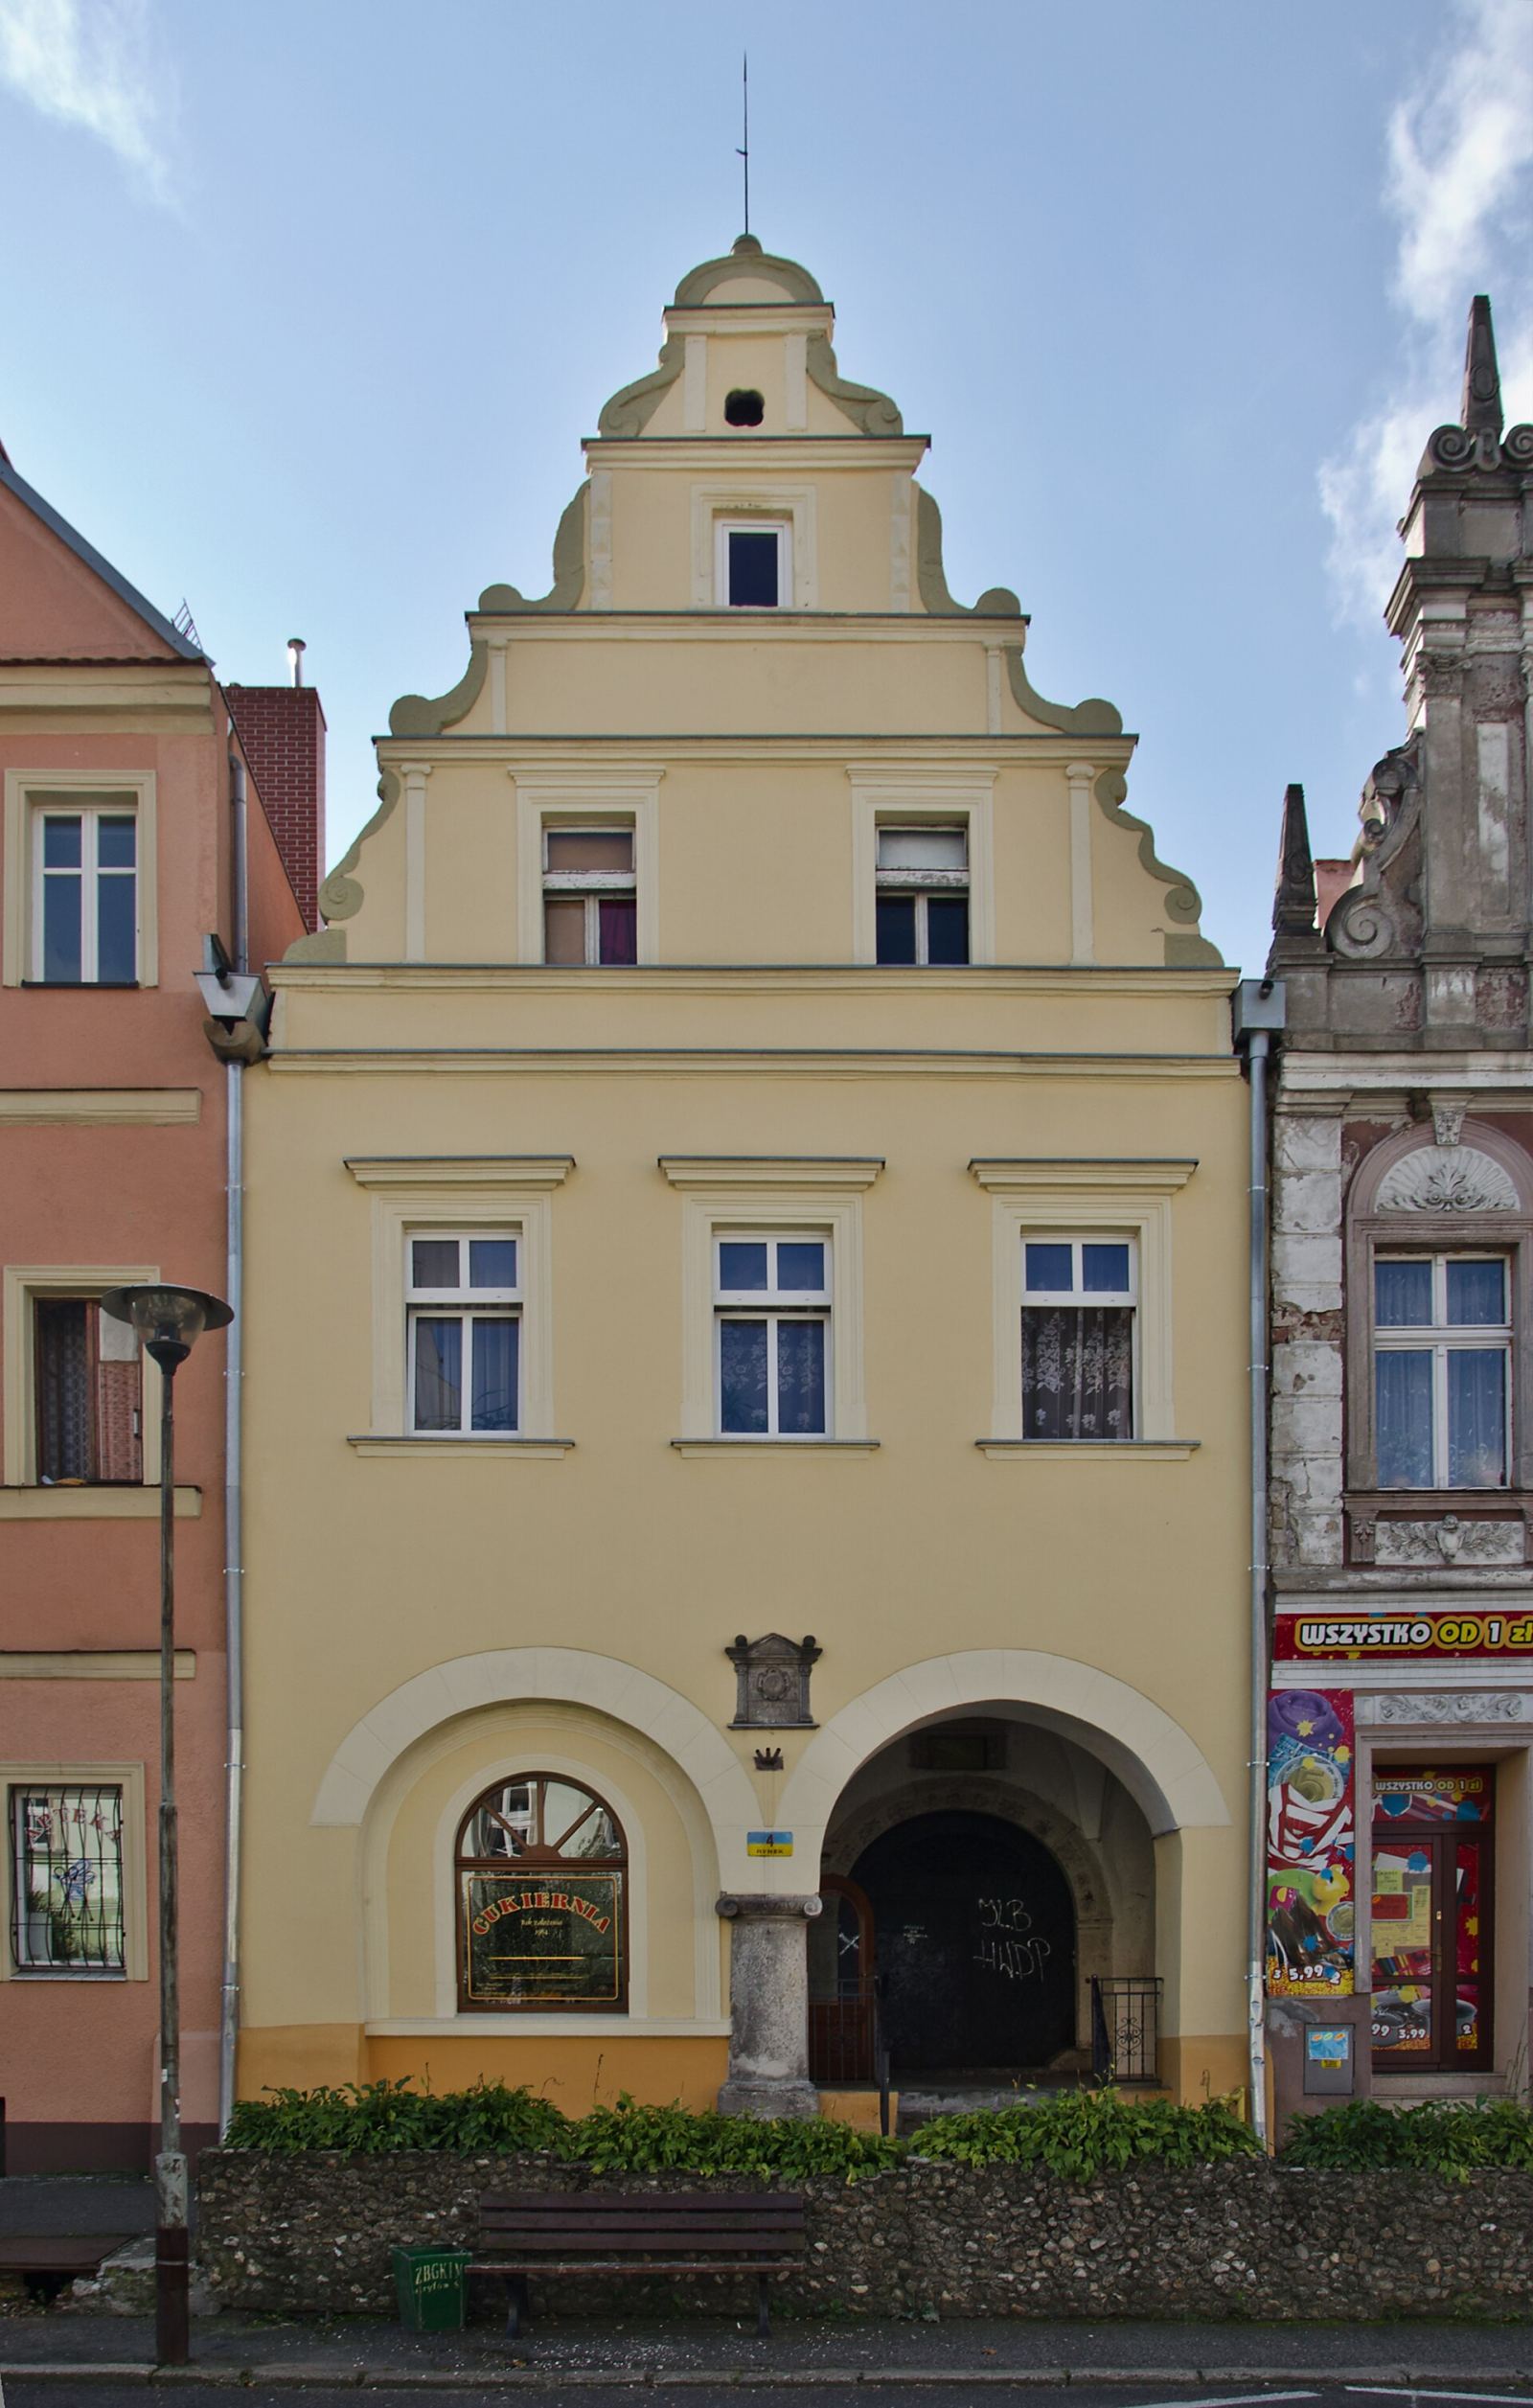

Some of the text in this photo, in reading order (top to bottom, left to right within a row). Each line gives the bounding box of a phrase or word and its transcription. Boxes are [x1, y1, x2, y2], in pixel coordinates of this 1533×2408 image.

[1301, 1622, 1430, 1645] WSZYSTKO
[1439, 1621, 1478, 1643] OD
[1490, 1621, 1500, 1642] 1
[1375, 1780, 1433, 1791] WSZYSTKO
[1437, 1780, 1454, 1790] OD
[1459, 1780, 1465, 1790] 1
[25, 1808, 122, 1844] APTEKA
[766, 1833, 775, 1847] 4
[472, 1892, 611, 1935] CUKIERNIA
[1289, 1964, 1324, 1982] 5,99
[1398, 2029, 1426, 2040] 3,99
